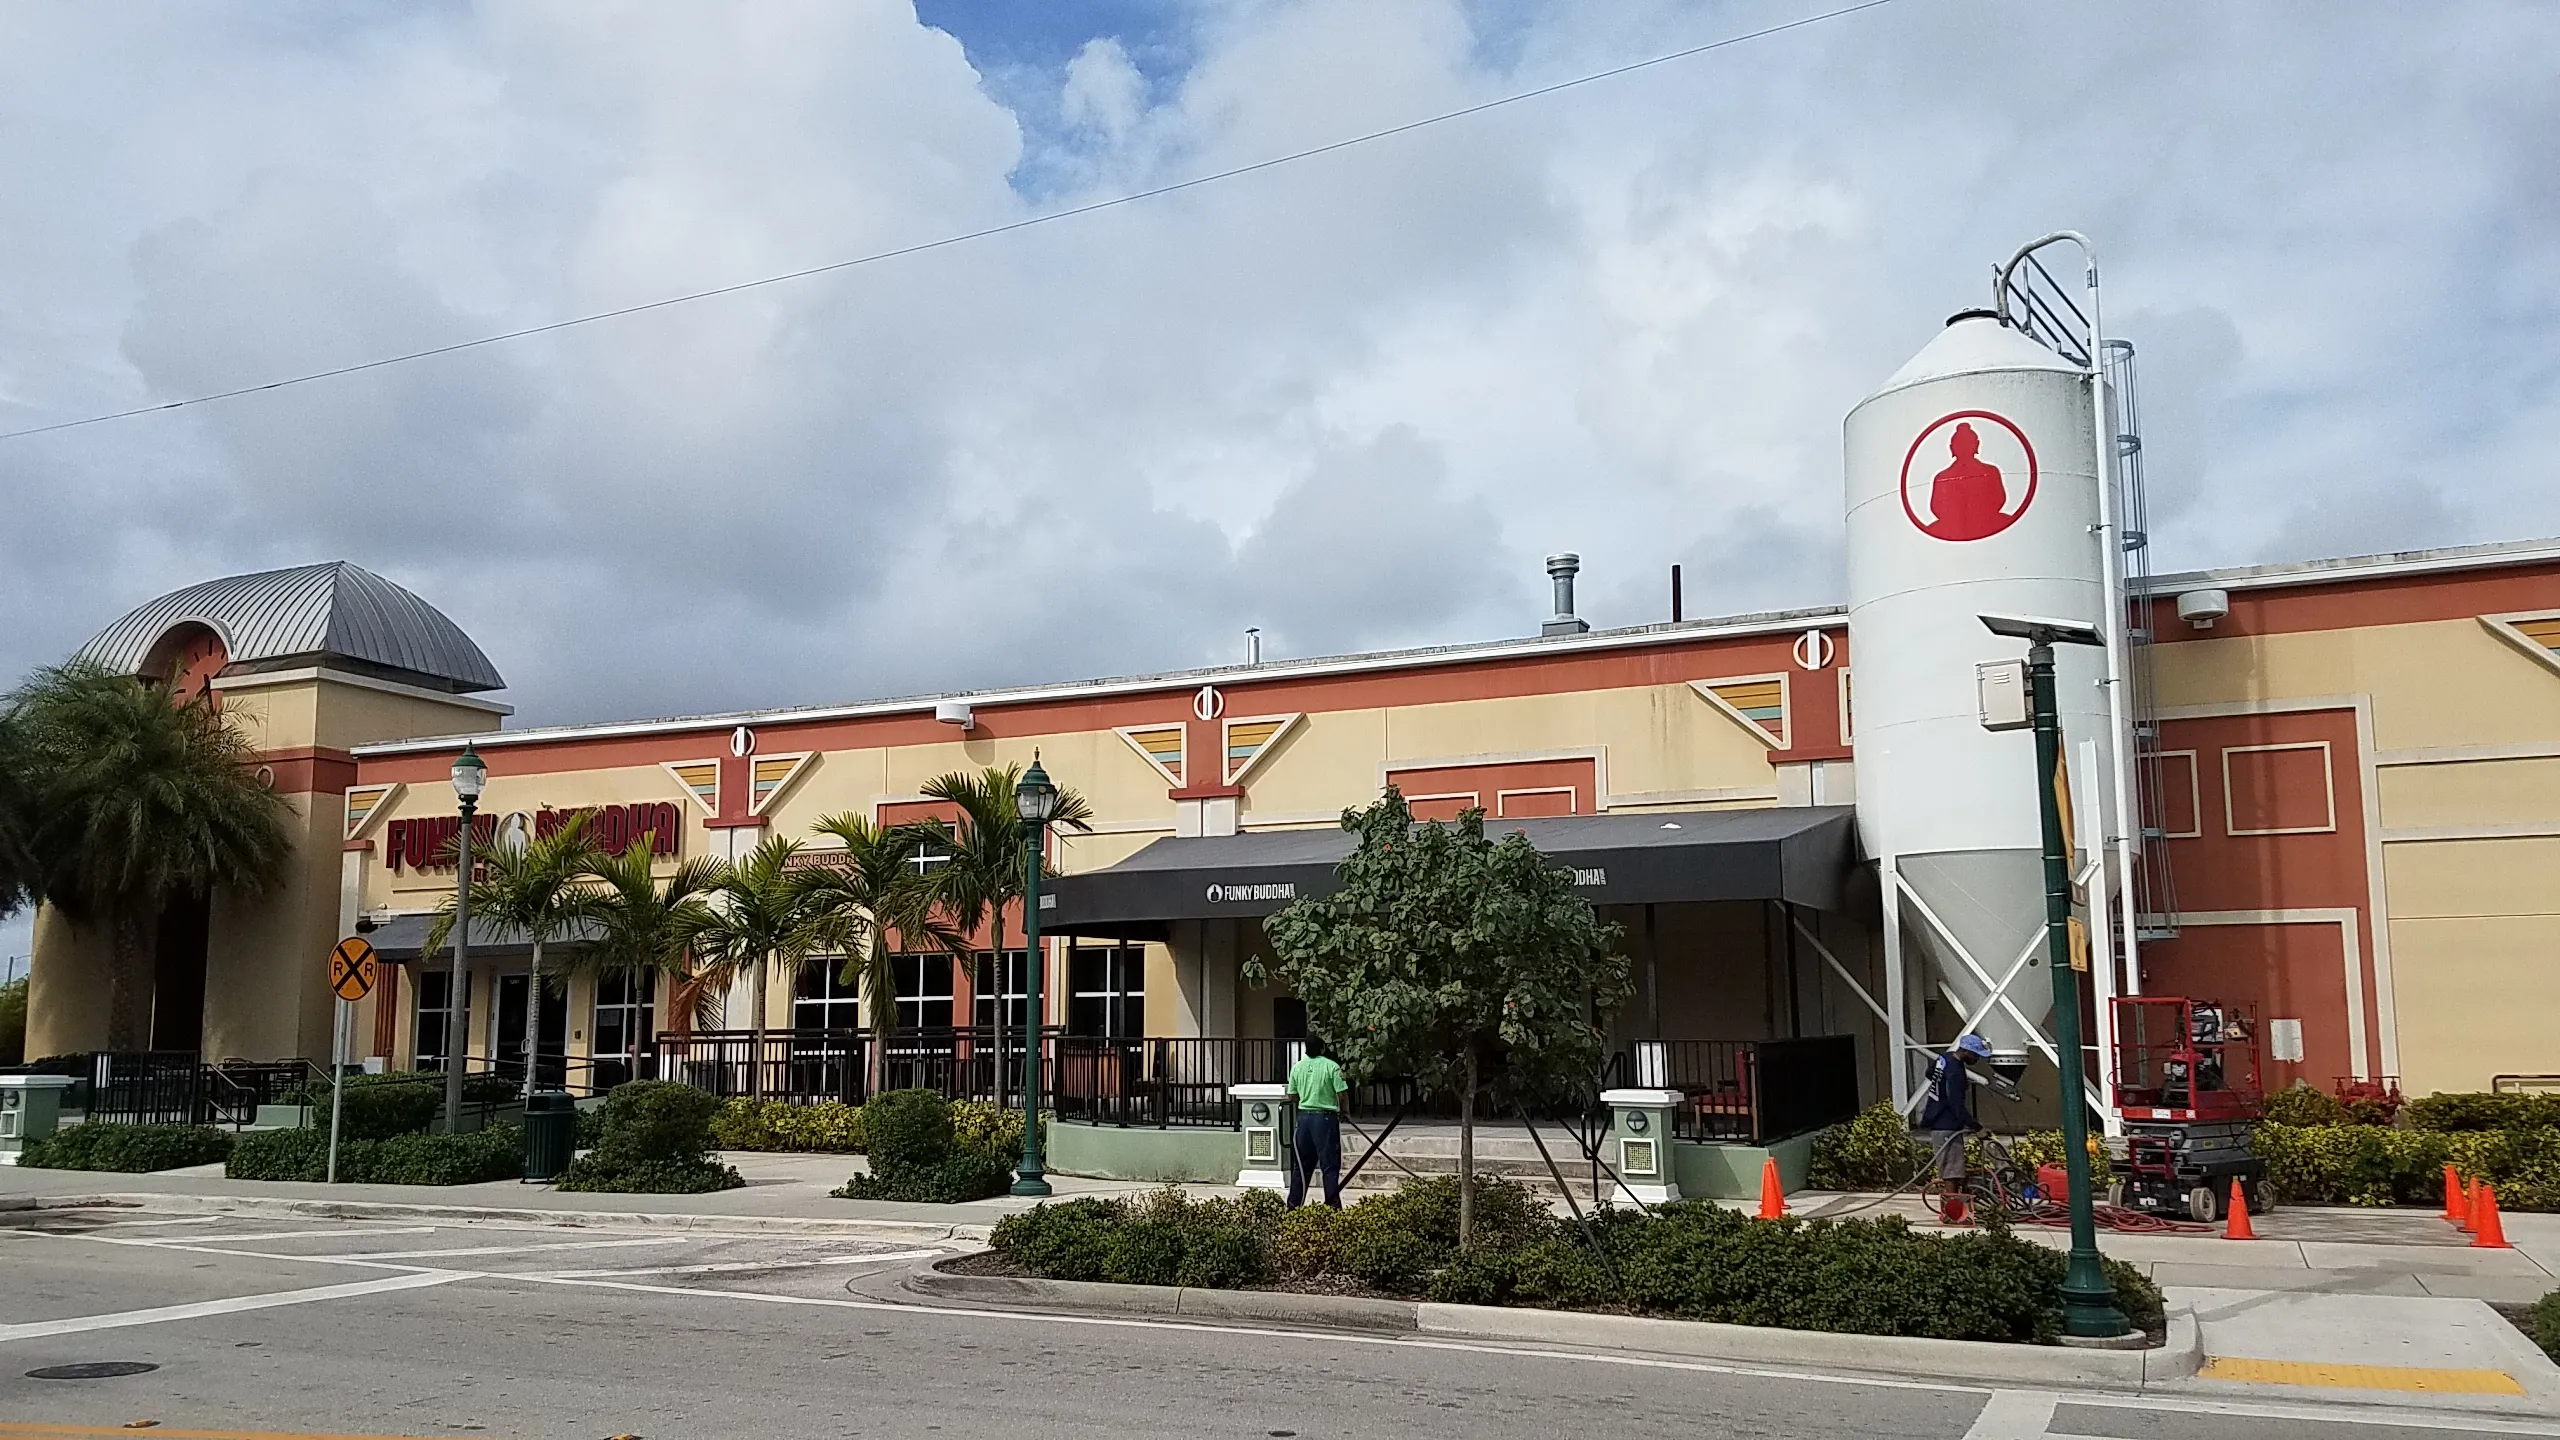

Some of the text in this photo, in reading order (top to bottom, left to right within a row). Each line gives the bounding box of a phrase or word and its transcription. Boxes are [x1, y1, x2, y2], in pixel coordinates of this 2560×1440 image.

[784, 852, 860, 867] NKY BUDDH
[1224, 884, 1253, 901] FUNKY
[1253, 883, 1290, 900] BUDDHA
[333, 961, 374, 977] R R
